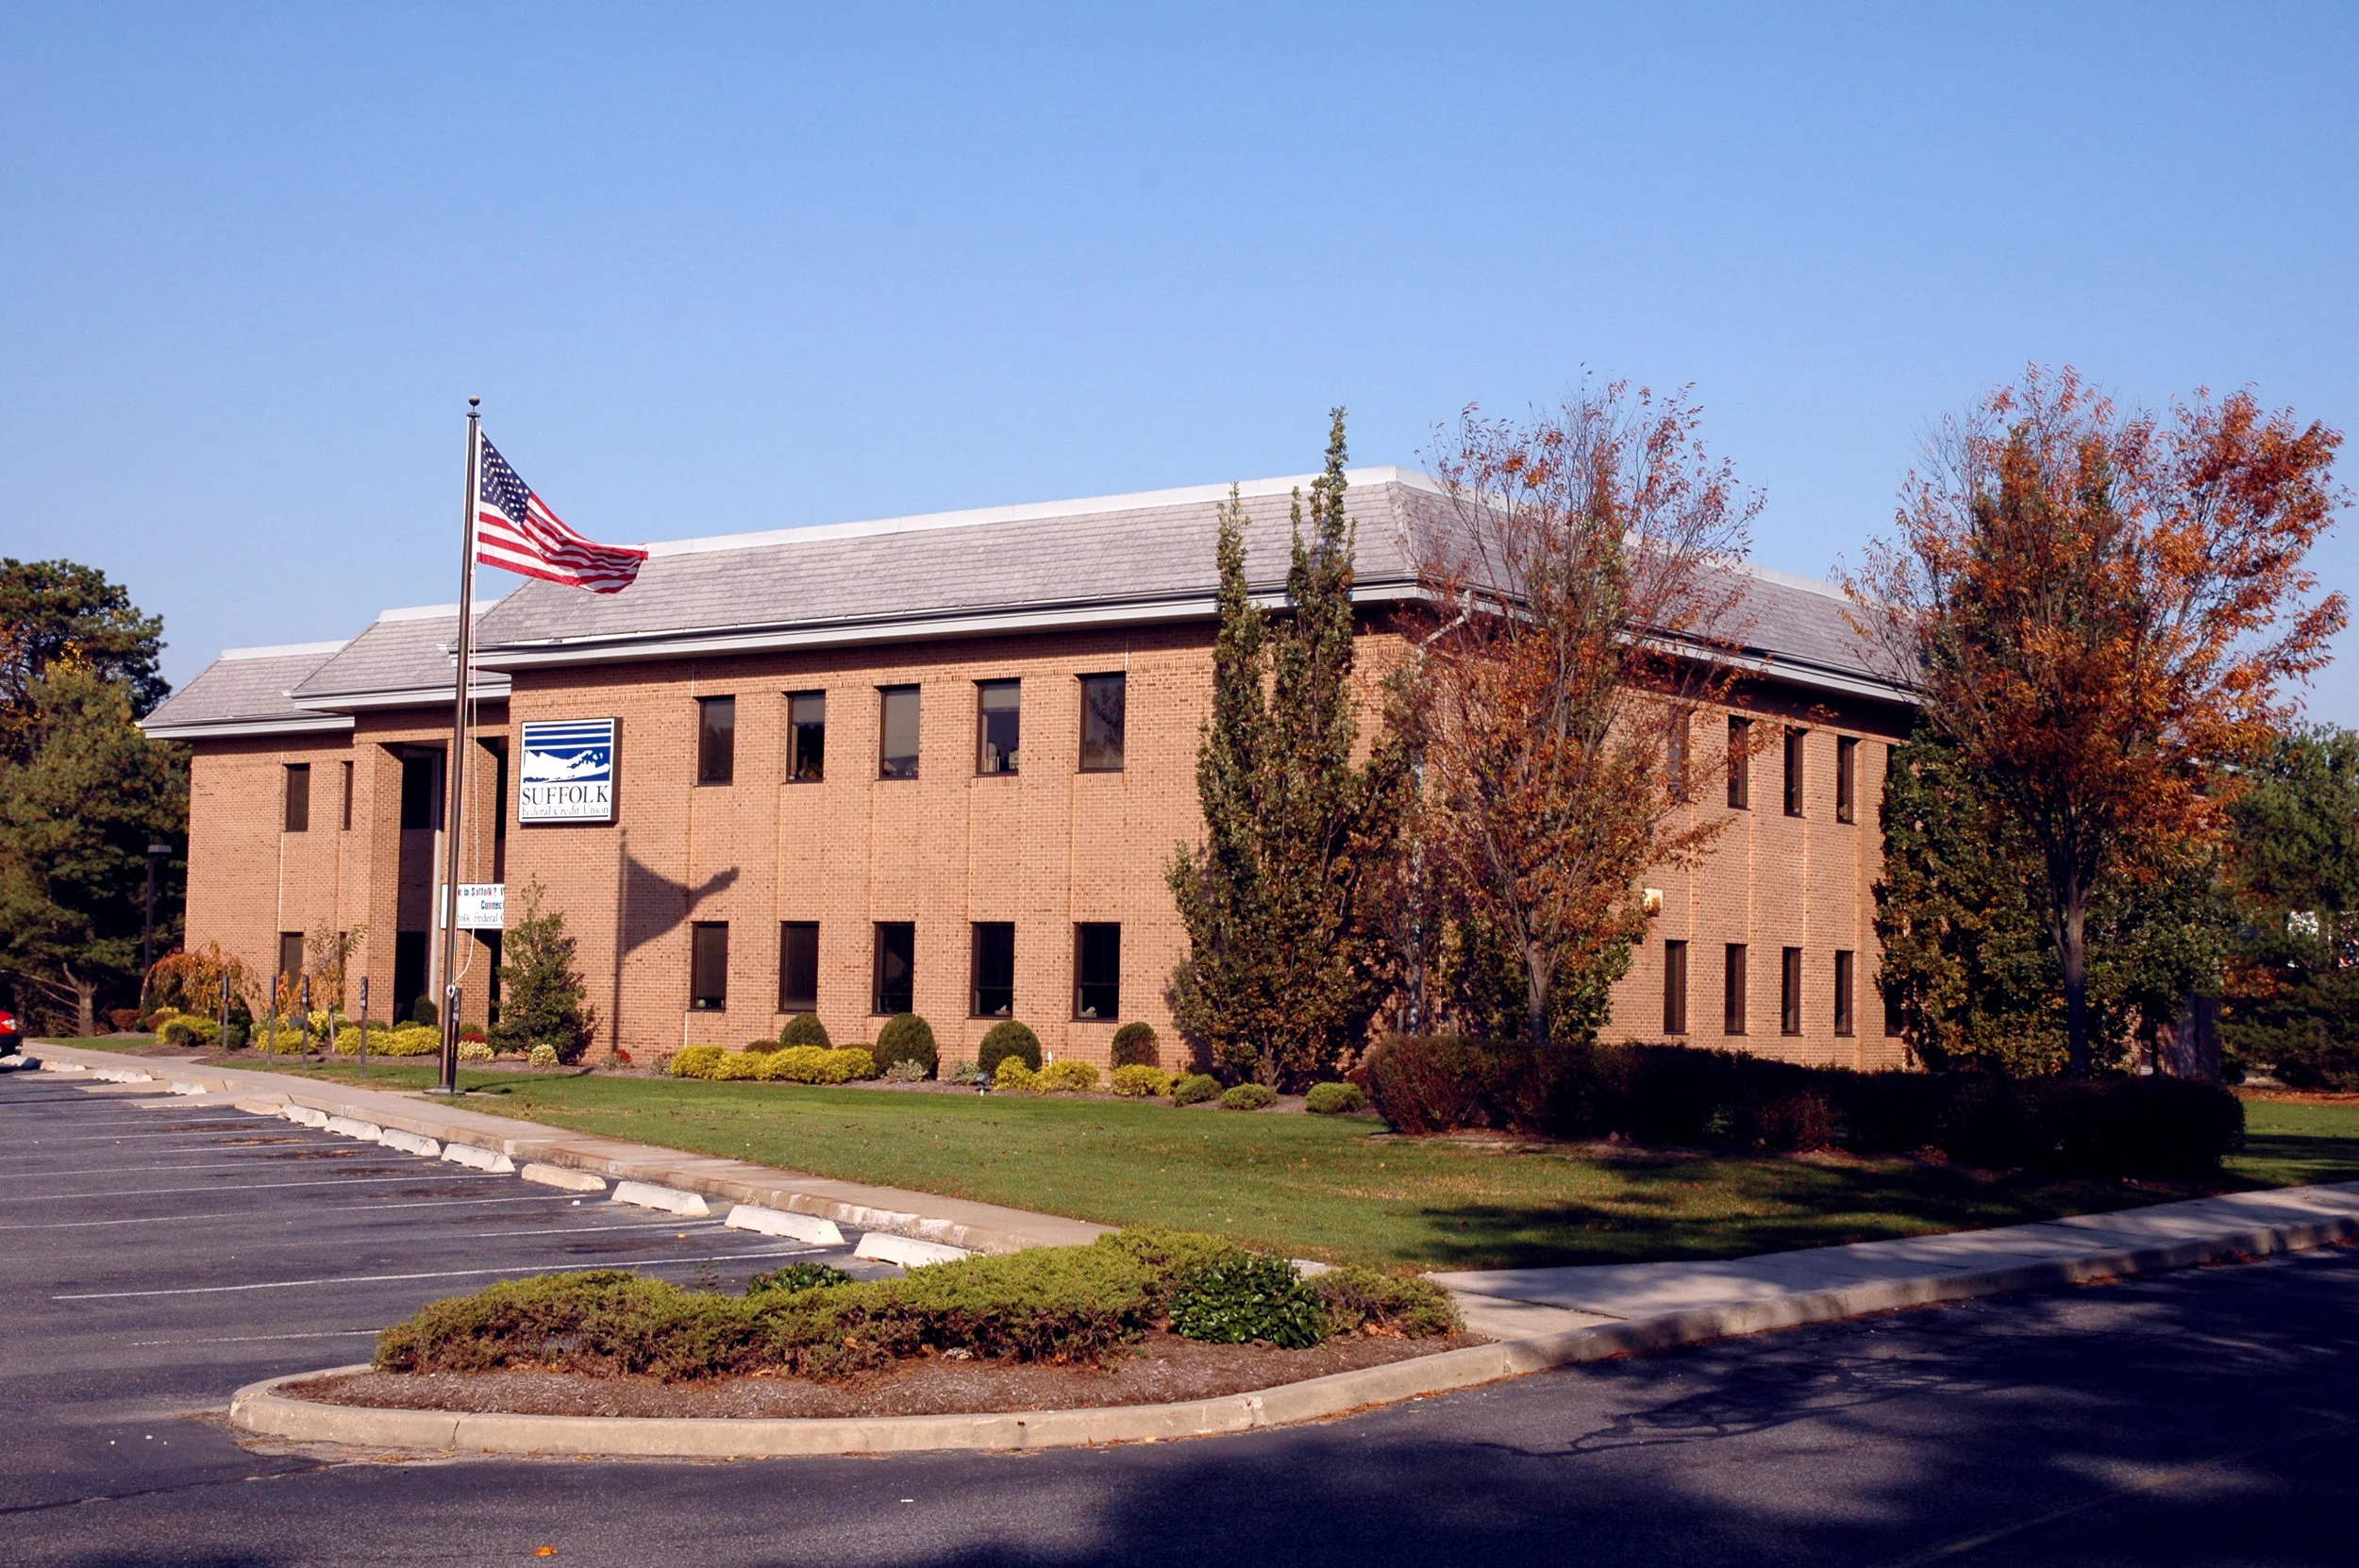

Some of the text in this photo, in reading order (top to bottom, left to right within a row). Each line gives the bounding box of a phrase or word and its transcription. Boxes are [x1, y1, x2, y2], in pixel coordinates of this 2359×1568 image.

[522, 785, 609, 806] SUFFOLK
[522, 804, 609, 816] Federal Credit Union
[481, 900, 503, 909] Connec
